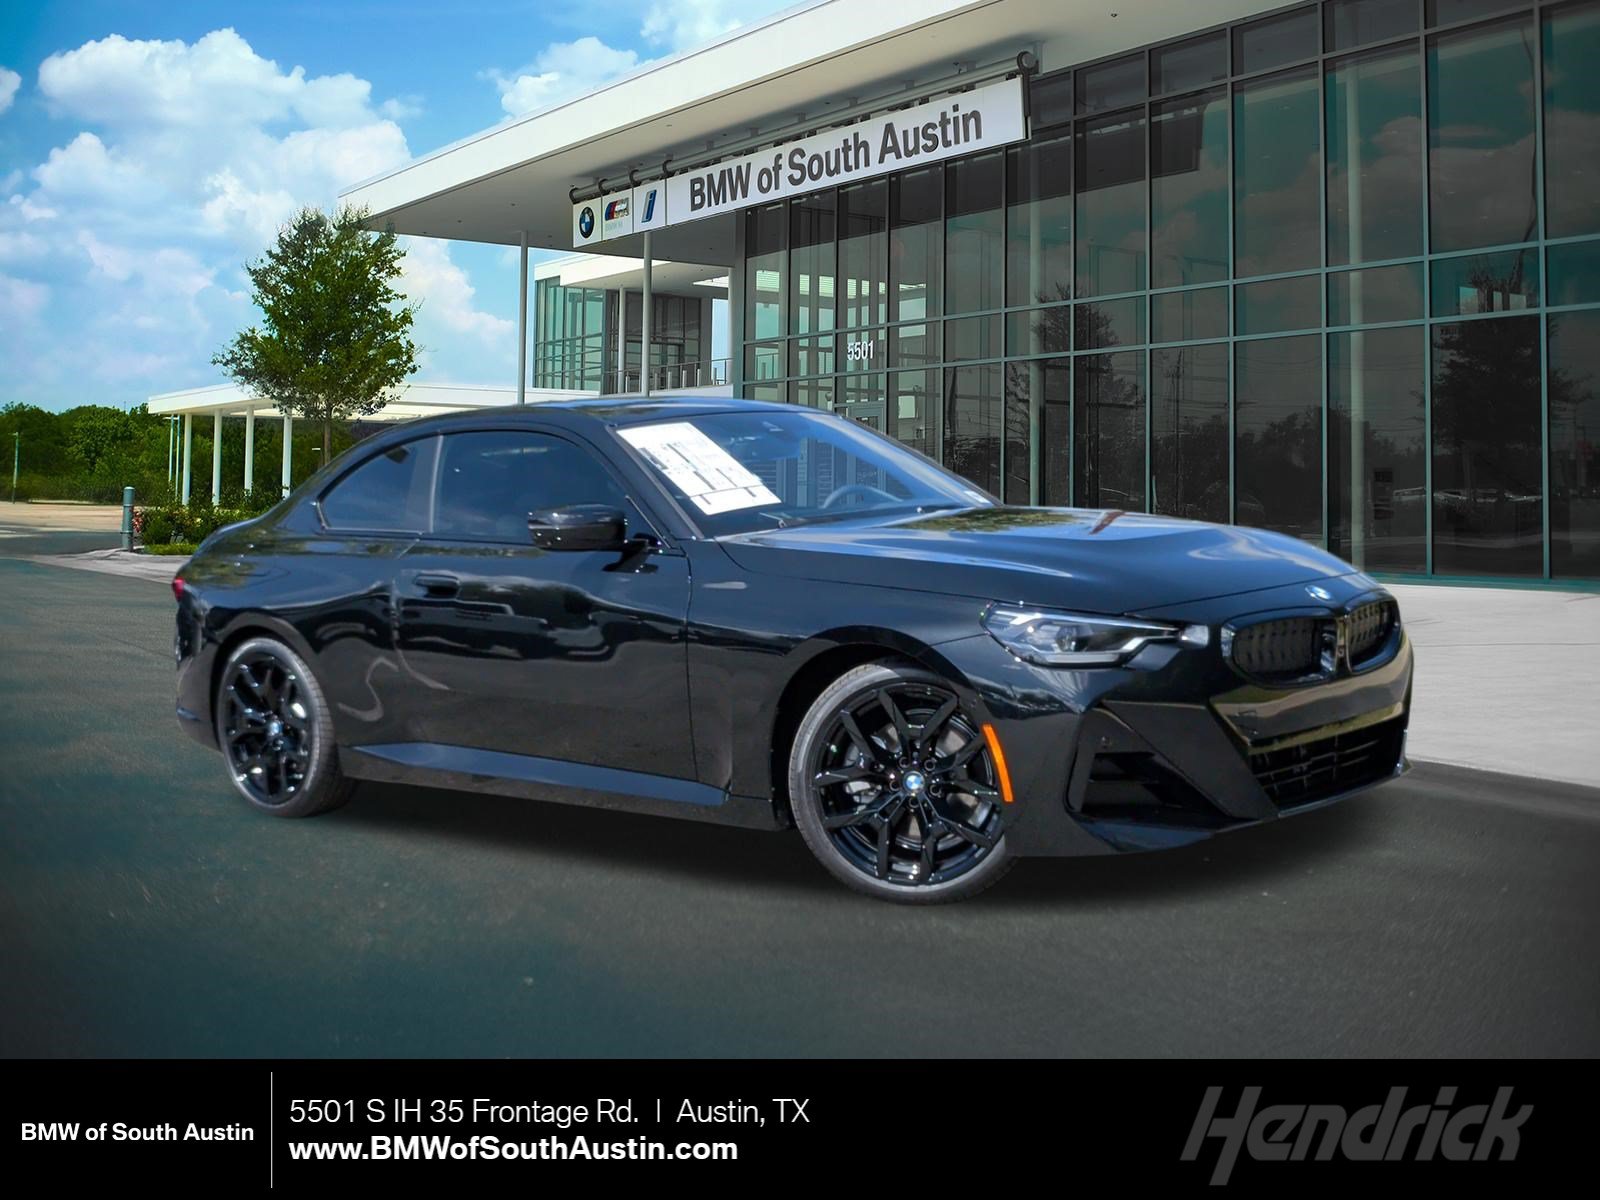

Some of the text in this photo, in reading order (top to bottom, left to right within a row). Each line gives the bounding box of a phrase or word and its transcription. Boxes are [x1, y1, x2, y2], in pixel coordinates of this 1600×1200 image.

[690, 104, 981, 211] BMW of South Austin
[847, 340, 873, 360] 5501
